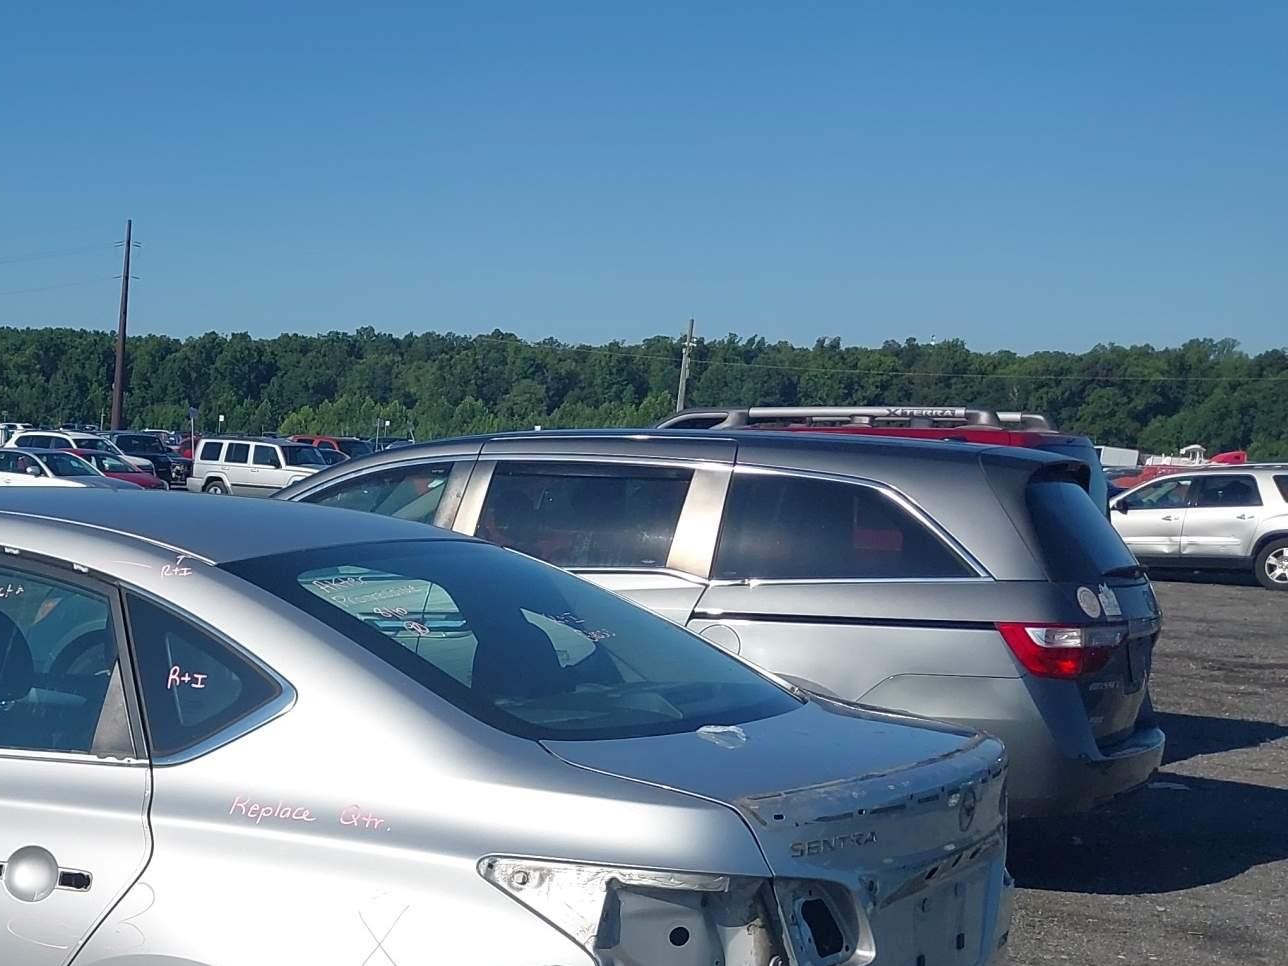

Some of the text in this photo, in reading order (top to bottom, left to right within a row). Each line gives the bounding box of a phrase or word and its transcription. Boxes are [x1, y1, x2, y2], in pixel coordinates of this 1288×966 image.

[167, 666, 208, 689] R+I
[229, 798, 317, 824] Replace
[790, 831, 879, 858] SENTRA
